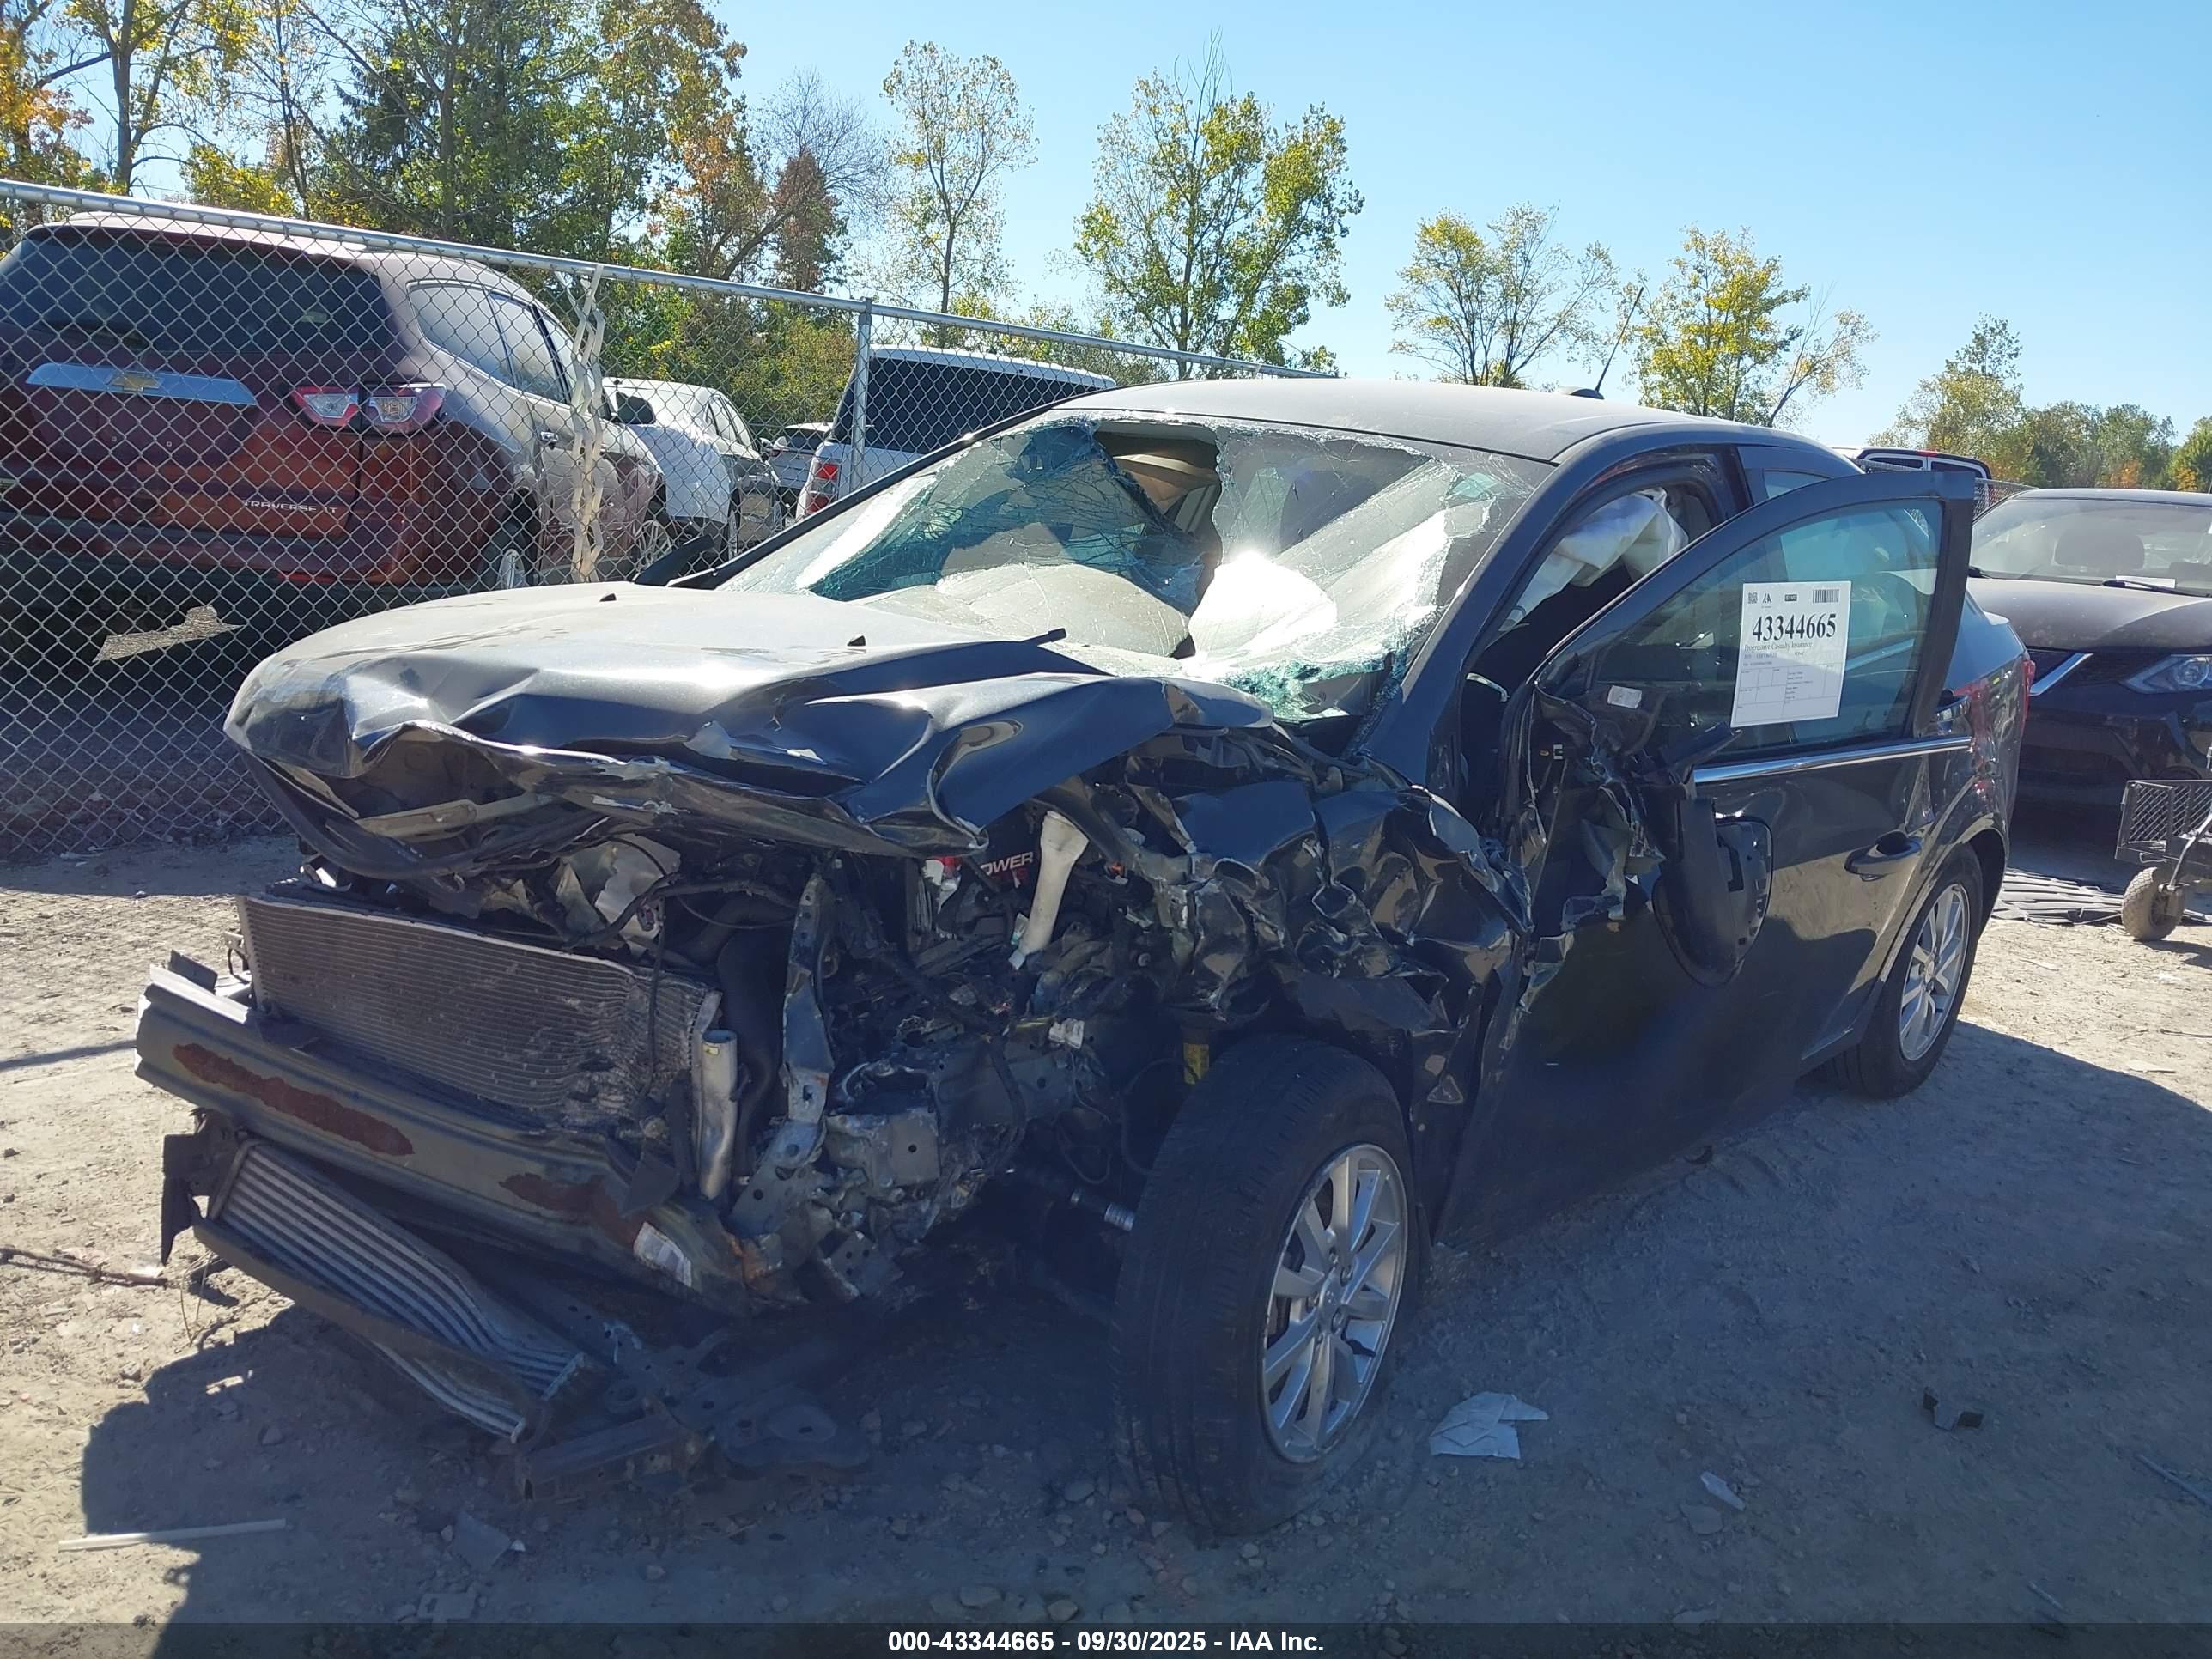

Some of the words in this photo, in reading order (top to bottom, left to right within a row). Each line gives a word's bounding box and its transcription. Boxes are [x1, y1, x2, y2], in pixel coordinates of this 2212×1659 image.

[241, 501, 317, 512] TRAVERSE
[1752, 613, 1837, 641] 43344665
[980, 851, 1034, 876] OWER
